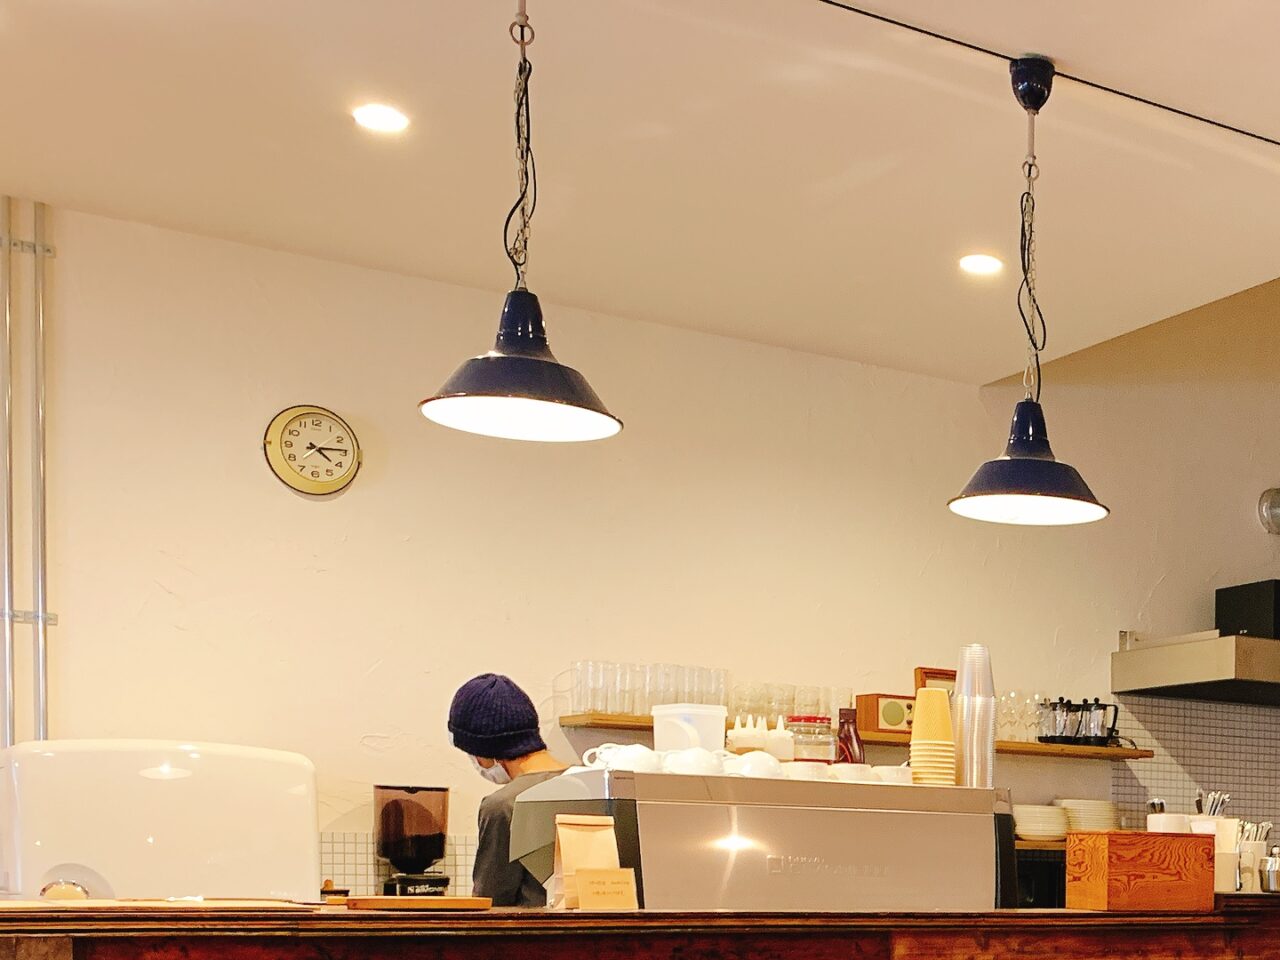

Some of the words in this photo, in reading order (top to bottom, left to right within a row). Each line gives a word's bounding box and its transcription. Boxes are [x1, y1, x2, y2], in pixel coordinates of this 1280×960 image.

[299, 420, 307, 428] 11
[311, 419, 322, 427] 12
[288, 429, 300, 437] 10
[284, 440, 293, 448] 9
[337, 436, 344, 444] 2
[288, 453, 297, 461] 8
[298, 464, 306, 472] 7
[325, 468, 334, 476] 5
[311, 470, 320, 478] 6
